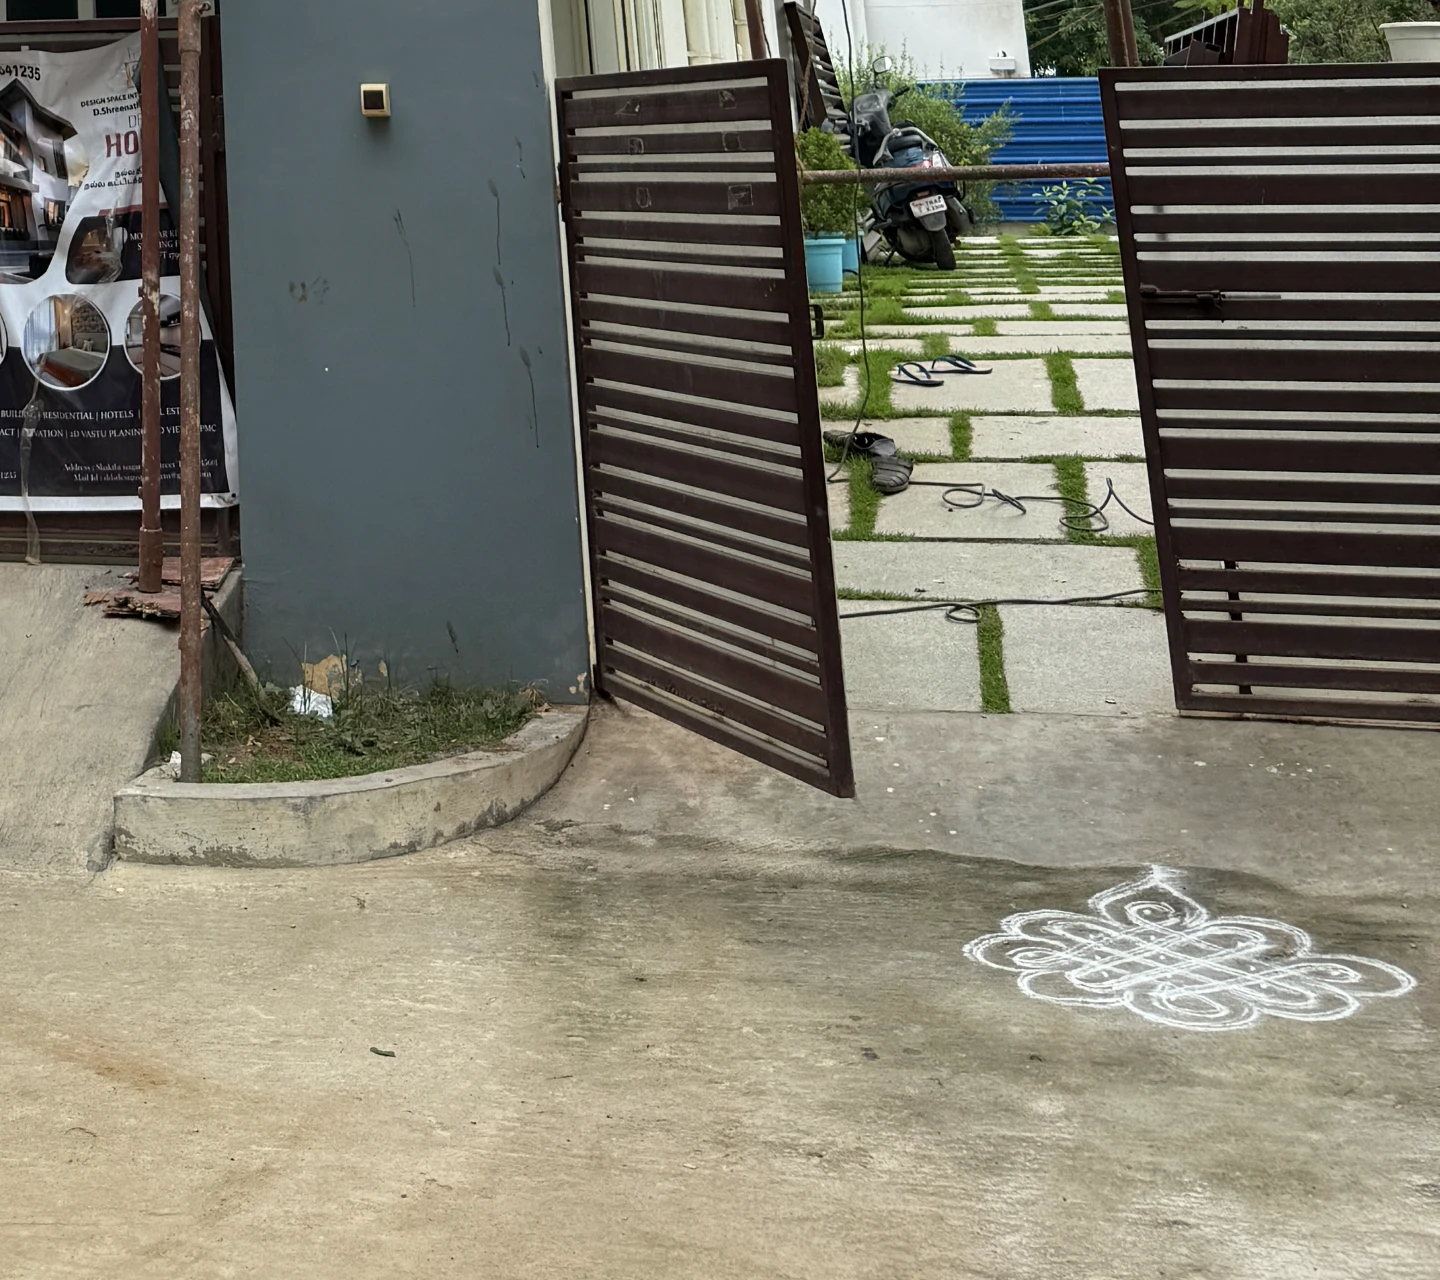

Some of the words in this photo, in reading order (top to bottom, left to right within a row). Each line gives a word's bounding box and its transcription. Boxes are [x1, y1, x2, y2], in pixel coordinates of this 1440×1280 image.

[80, 96, 106, 108] DESIGN
[106, 94, 127, 104] SPACE
[42, 411, 94, 421] RESIDENTIAL
[101, 409, 134, 420] HOTELS
[81, 428, 107, 438] VASTU
